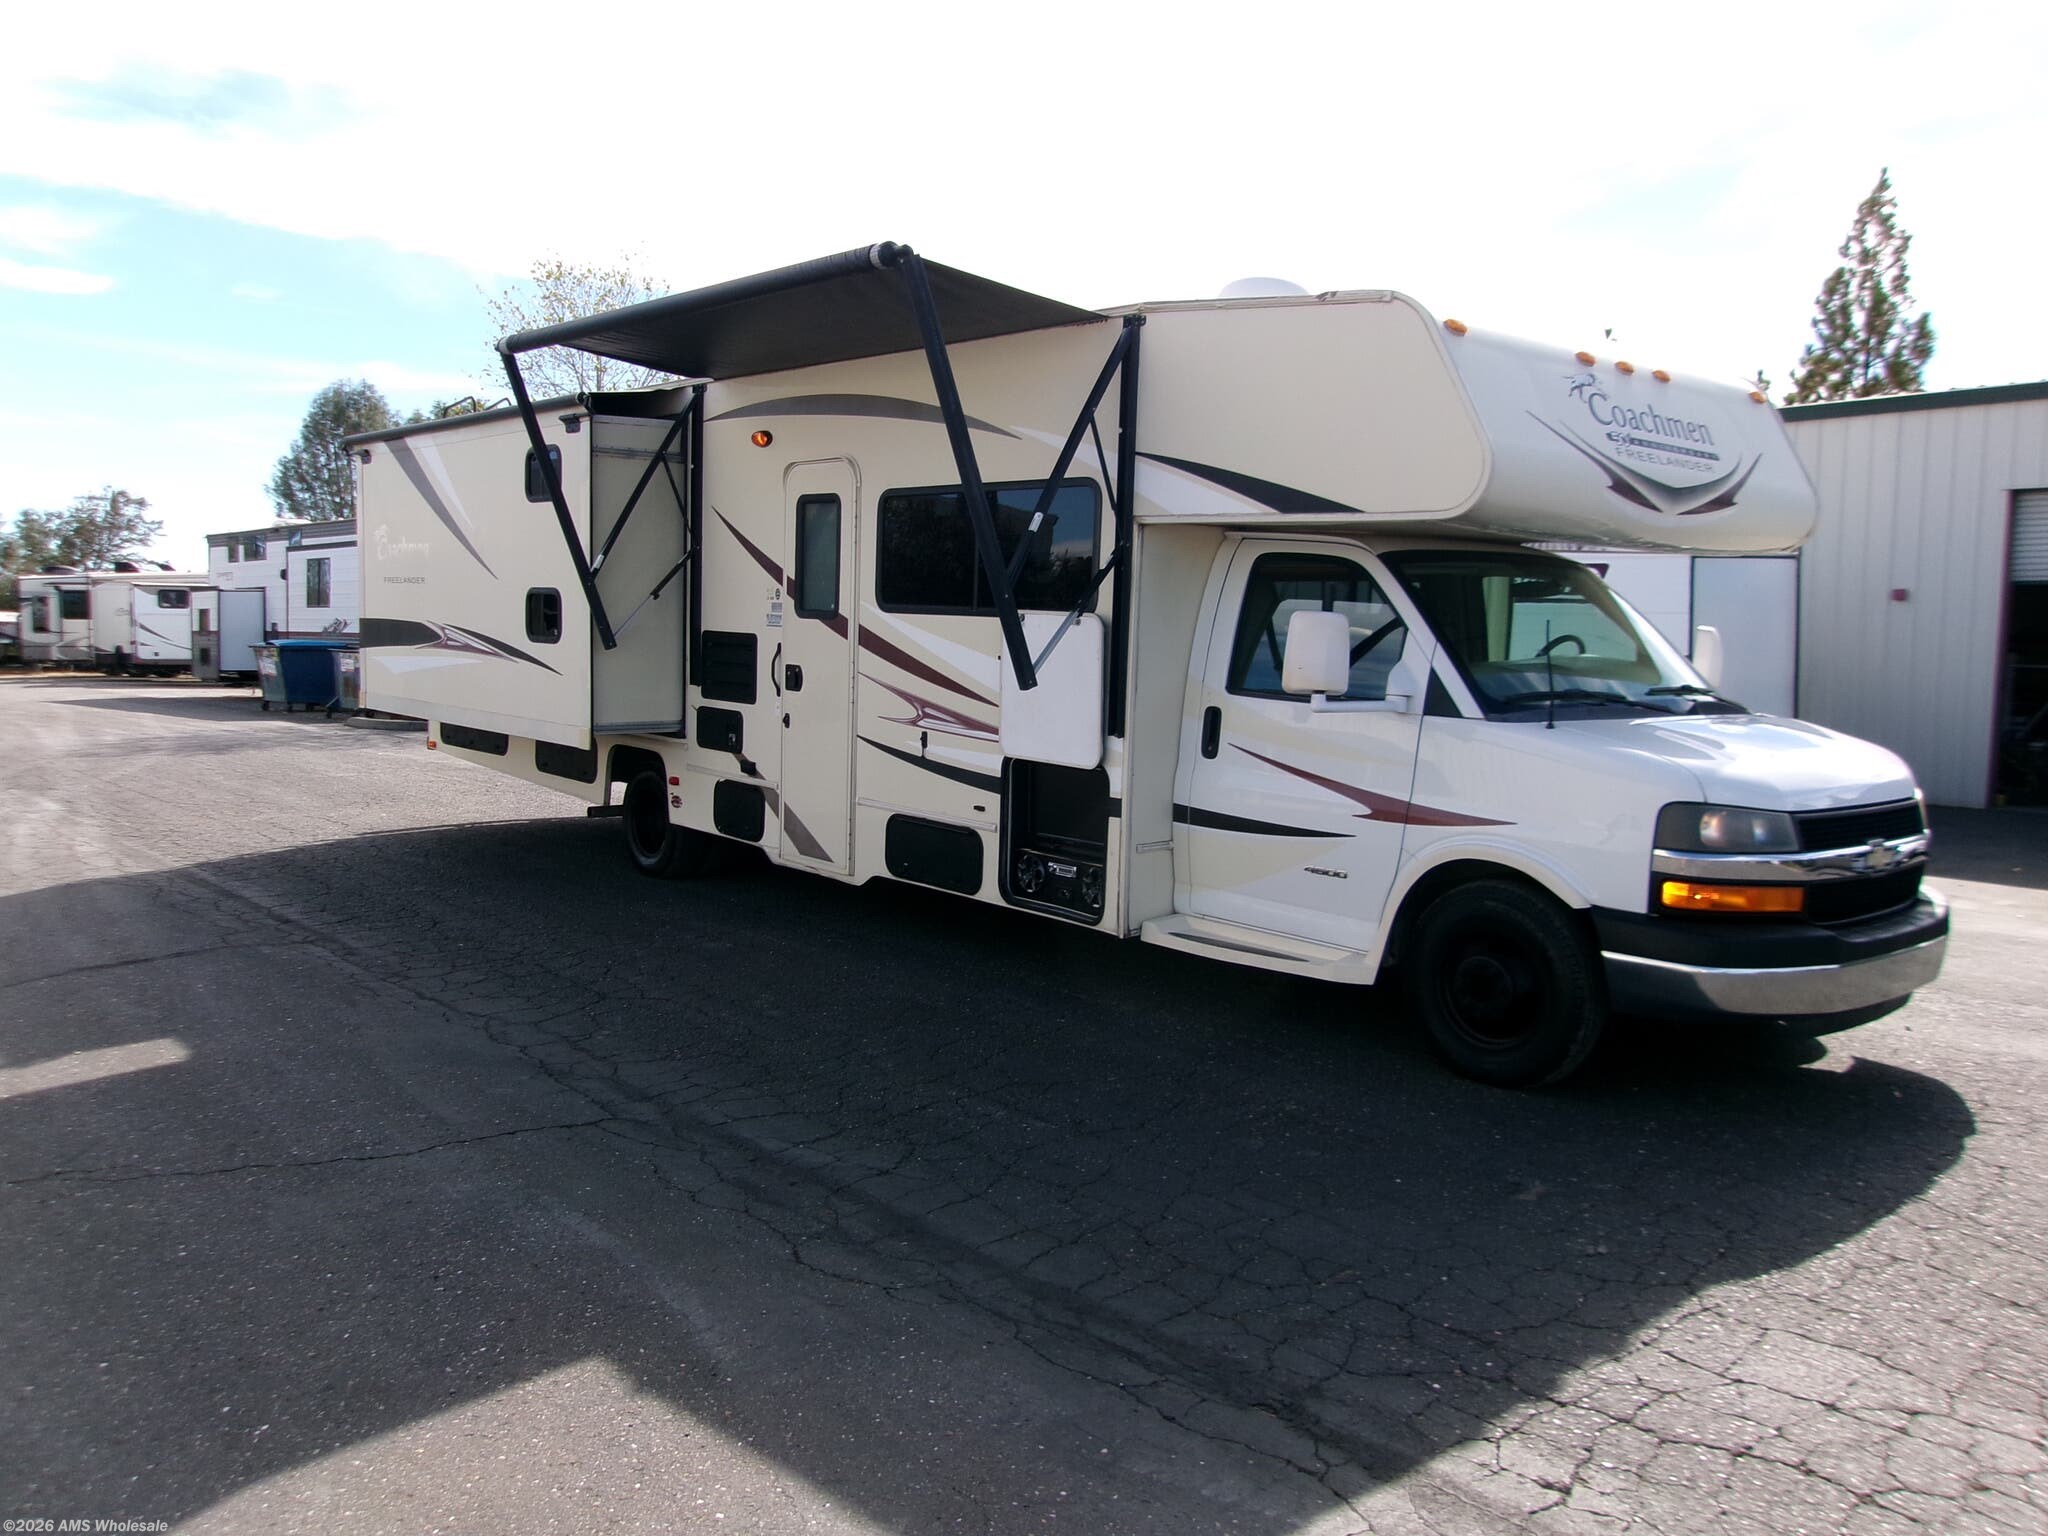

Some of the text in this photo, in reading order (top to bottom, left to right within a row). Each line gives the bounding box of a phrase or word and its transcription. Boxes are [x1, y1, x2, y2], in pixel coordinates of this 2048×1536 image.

[1588, 392, 1715, 446] Coachmen
[1616, 447, 1714, 472] FREELANDER
[383, 576, 426, 584] FREELANDER
